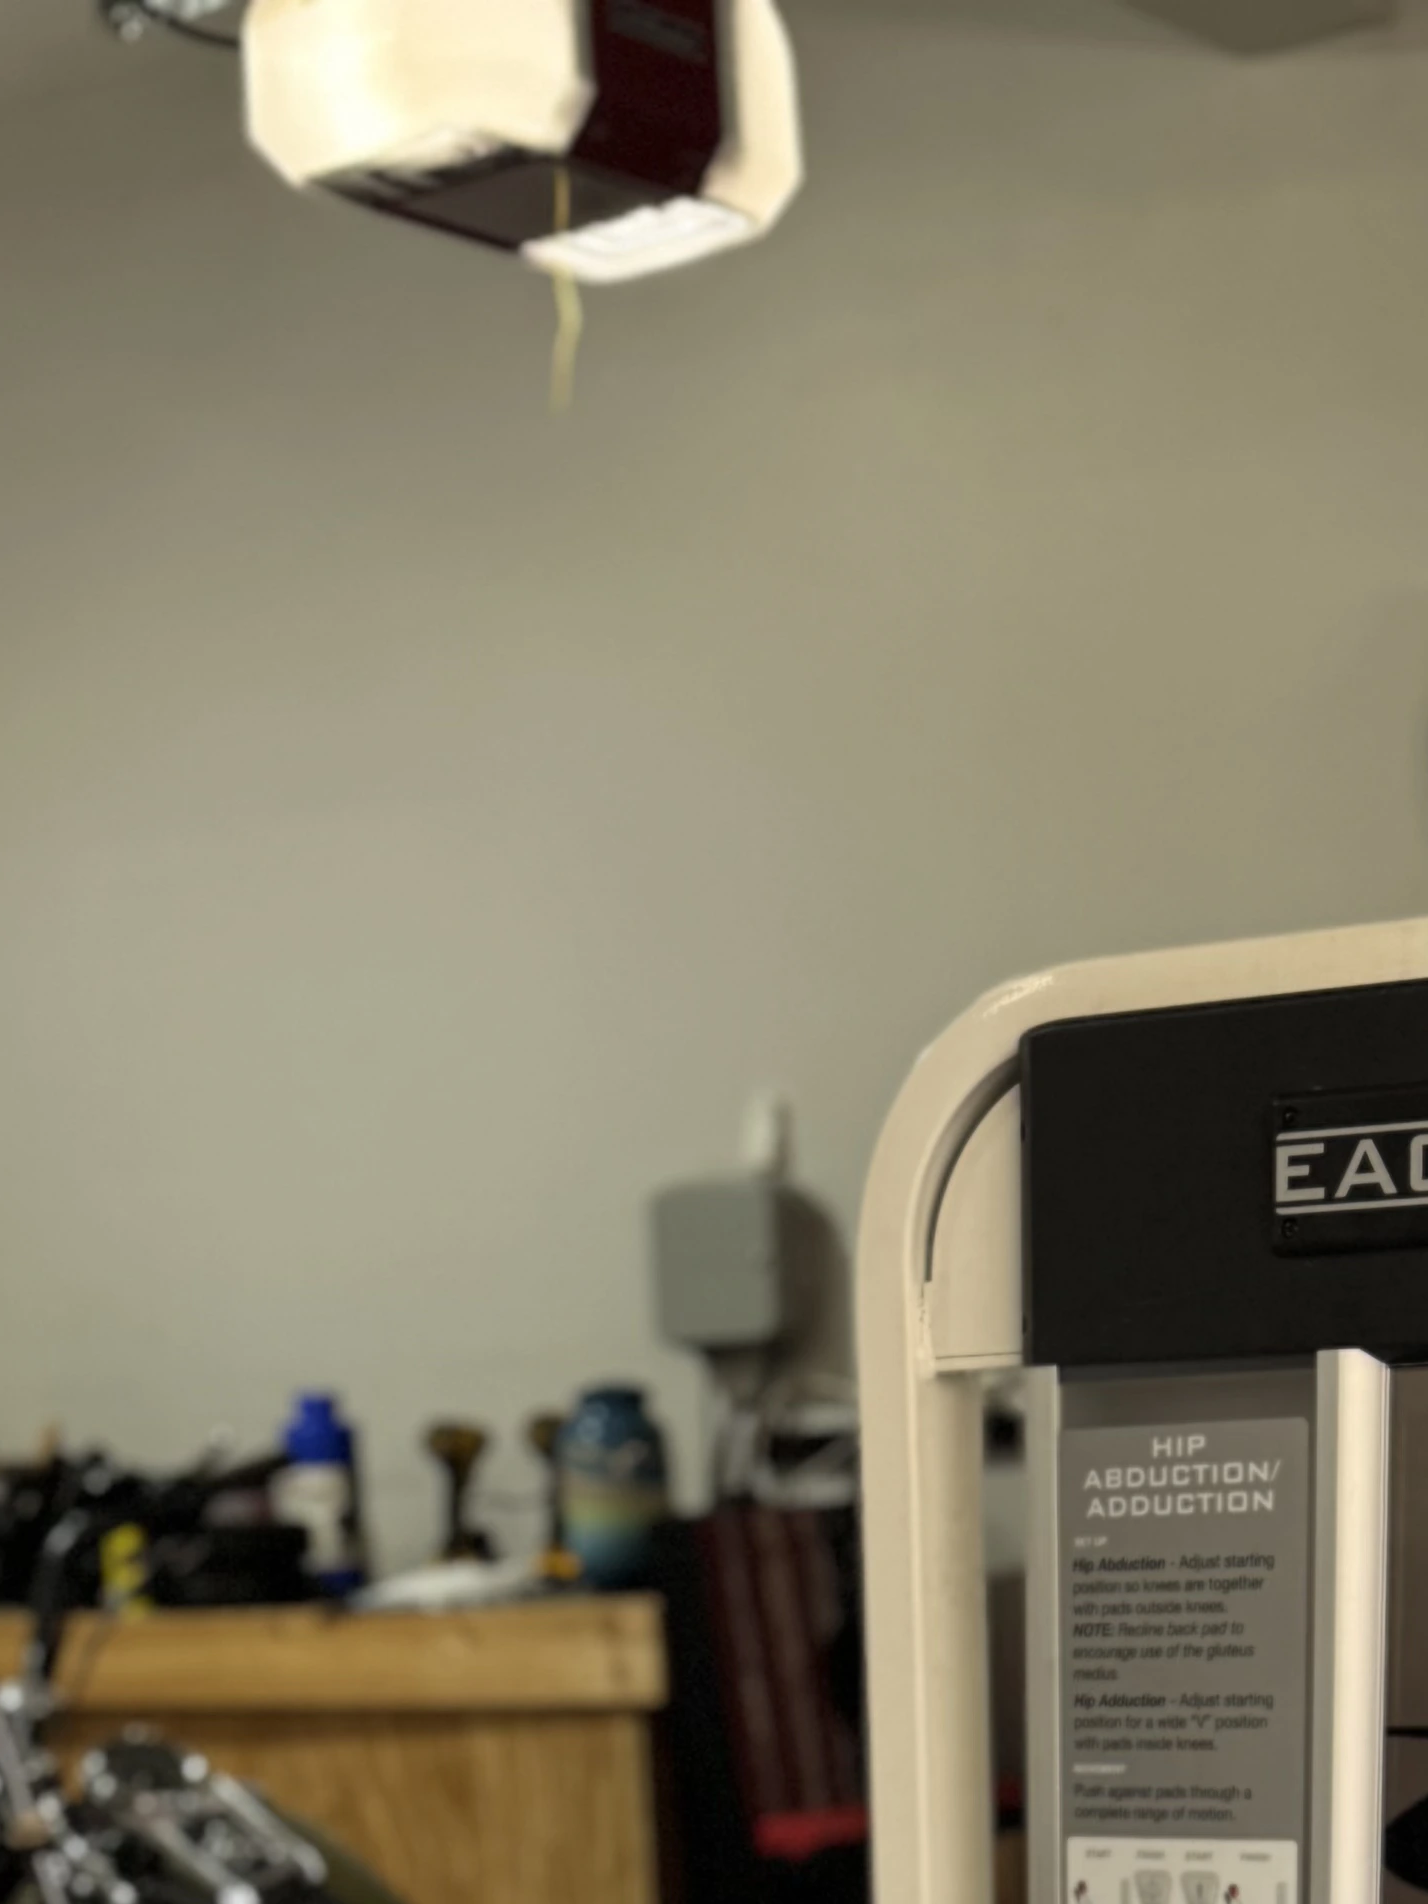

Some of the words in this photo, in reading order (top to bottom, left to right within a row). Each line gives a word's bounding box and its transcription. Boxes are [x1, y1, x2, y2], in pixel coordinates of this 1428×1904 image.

[1152, 1434, 1207, 1459] HIP
[1083, 1459, 1282, 1491] ABDUCTION/
[1086, 1489, 1276, 1519] ADDUCTION
[1072, 1559, 1095, 1574] Hip
[1098, 1557, 1165, 1572] Abduction
[1179, 1556, 1221, 1572] Adjust
[1224, 1554, 1275, 1570] starting
[1073, 1580, 1121, 1596] position
[1124, 1582, 1139, 1593] so
[1142, 1579, 1180, 1592] knees
[1184, 1580, 1205, 1591] are
[1208, 1576, 1264, 1593] together
[1073, 1602, 1098, 1616] with
[1101, 1602, 1132, 1617] pads
[1135, 1601, 1182, 1614] outside
[1074, 1624, 1114, 1638] NOTE:
[1118, 1622, 1164, 1636] Recline
[1167, 1622, 1198, 1635] back
[1201, 1622, 1228, 1637] pad
[1230, 1622, 1244, 1635] to
[1073, 1647, 1137, 1661] encourage
[1141, 1646, 1163, 1658] use
[1166, 1643, 1180, 1657] of
[1183, 1643, 1204, 1657] the
[1207, 1643, 1254, 1661] gluteus
[1074, 1693, 1096, 1709] Hip
[1098, 1694, 1166, 1708] Adduction
[1179, 1693, 1221, 1709] Adjust
[1224, 1693, 1274, 1709] starting
[1074, 1716, 1122, 1730] position
[1126, 1715, 1141, 1728] for
[1157, 1715, 1187, 1729] wide
[1214, 1715, 1268, 1730] position
[1074, 1737, 1099, 1750] with
[1102, 1737, 1133, 1752] pads
[1136, 1737, 1173, 1750] inside
[1155, 1786, 1187, 1801] pads
[1190, 1786, 1240, 1802] through
[1074, 1807, 1131, 1822] complete
[1173, 1807, 1186, 1820] of
